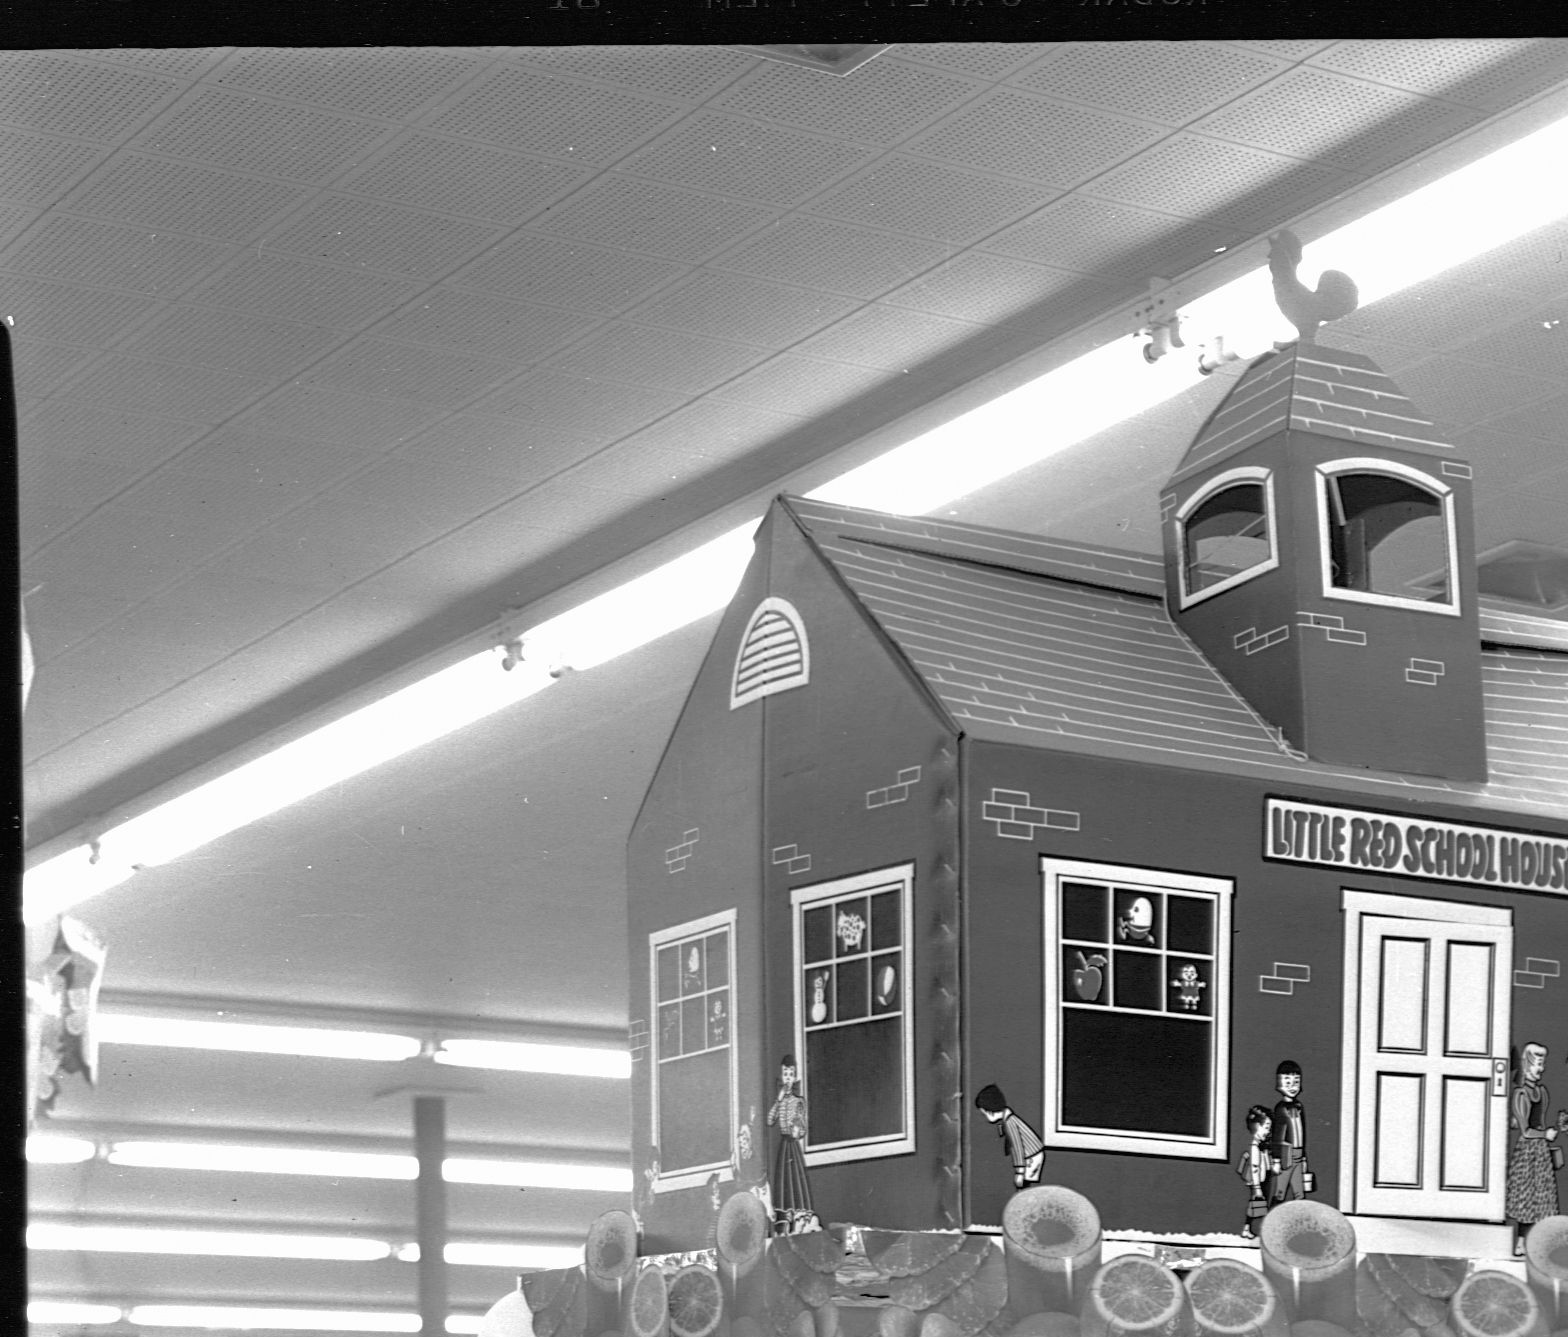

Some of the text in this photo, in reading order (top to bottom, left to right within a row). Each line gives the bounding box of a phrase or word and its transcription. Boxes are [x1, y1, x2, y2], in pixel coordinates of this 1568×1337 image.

[1272, 807, 1347, 863] LITTLE
[1350, 817, 1402, 870] RED
[1404, 825, 1498, 882] SCHOOL
